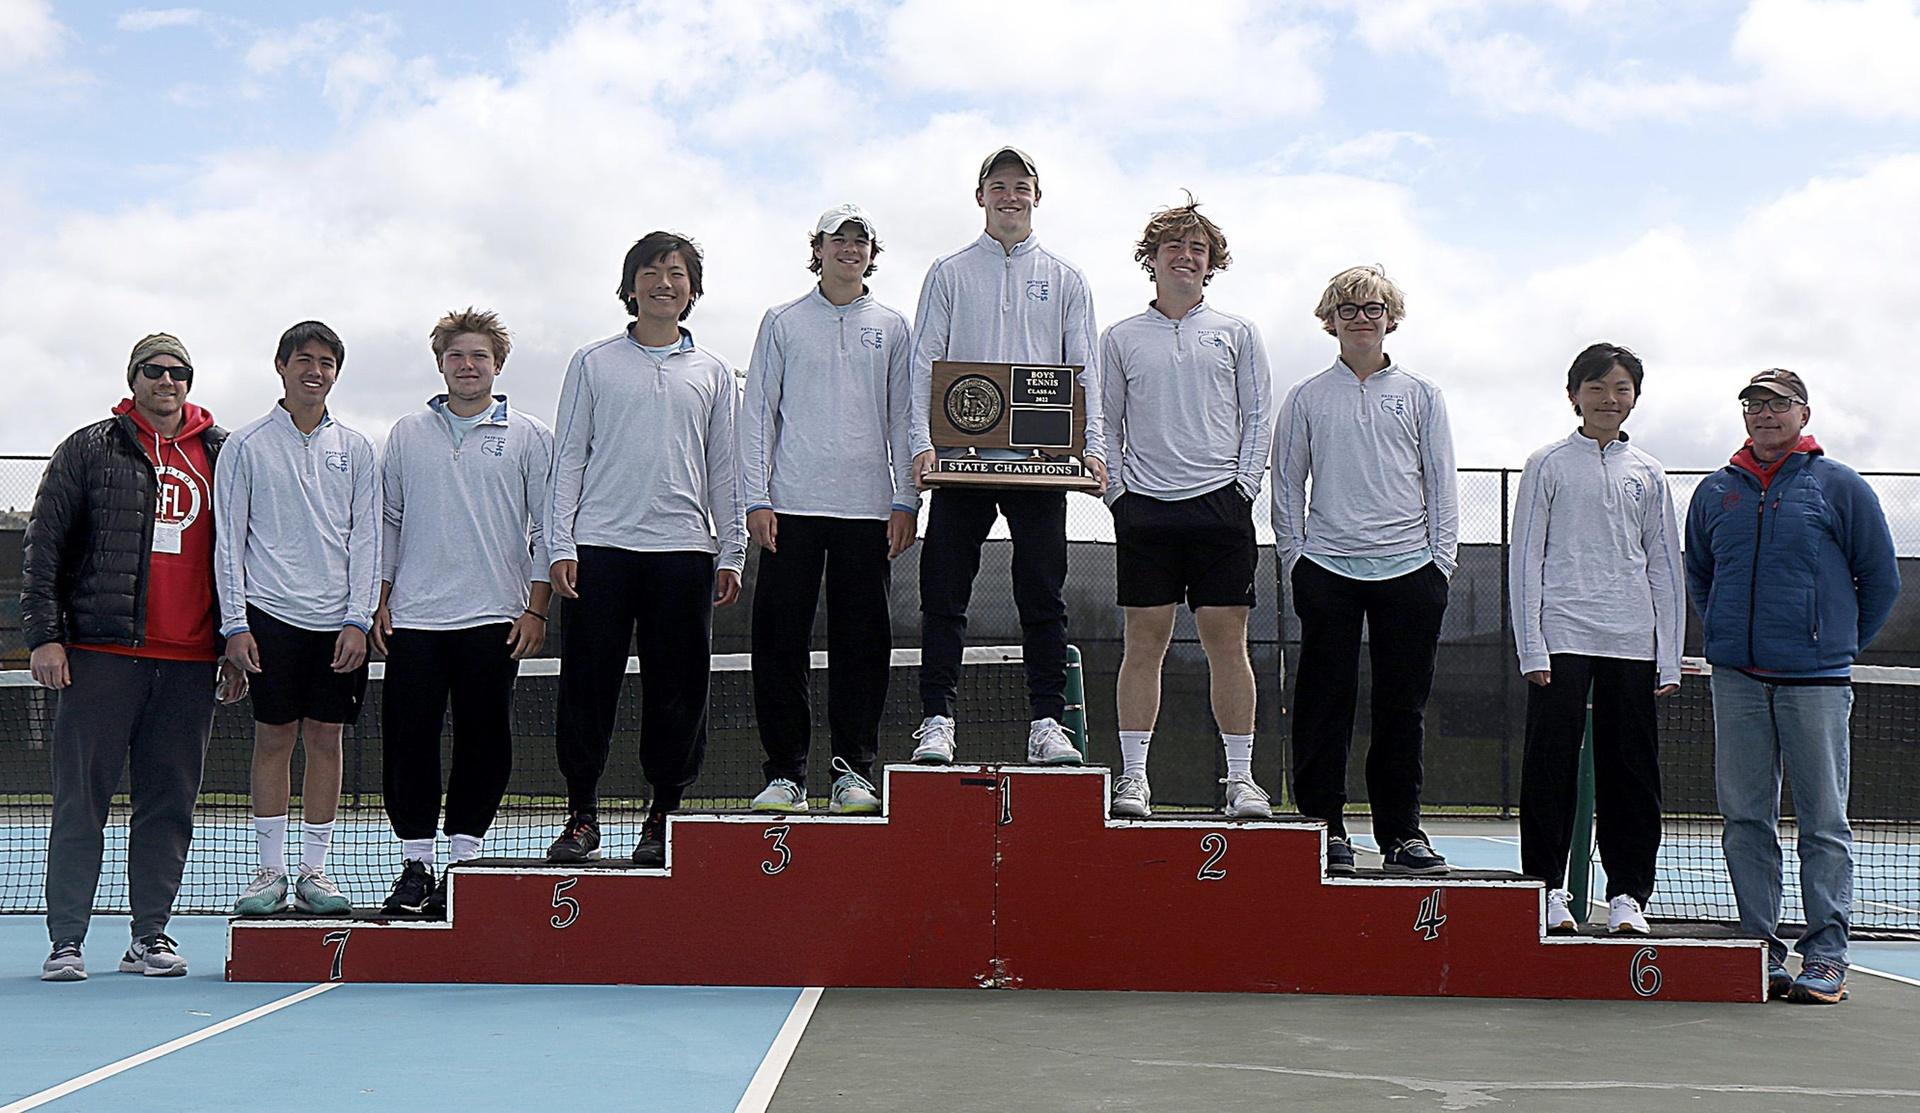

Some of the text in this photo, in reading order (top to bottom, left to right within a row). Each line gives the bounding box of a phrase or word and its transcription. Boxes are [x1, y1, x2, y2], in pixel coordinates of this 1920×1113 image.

[1040, 284, 1049, 301] LHS
[875, 332, 883, 349] LHS
[1025, 378, 1059, 387] TENNIS
[1031, 371, 1055, 379] BOYS
[1395, 399, 1404, 416] LHS
[494, 440, 505, 457] LHS
[340, 455, 348, 473] LHS
[948, 462, 1073, 476] STATE CHAMPIONS
[1000, 775, 1013, 825] 1
[761, 824, 791, 875] 3
[1197, 832, 1228, 881] 2
[550, 877, 580, 929] 5
[1413, 888, 1447, 941] 4
[323, 928, 351, 981] 7
[1630, 946, 1662, 997] 6
